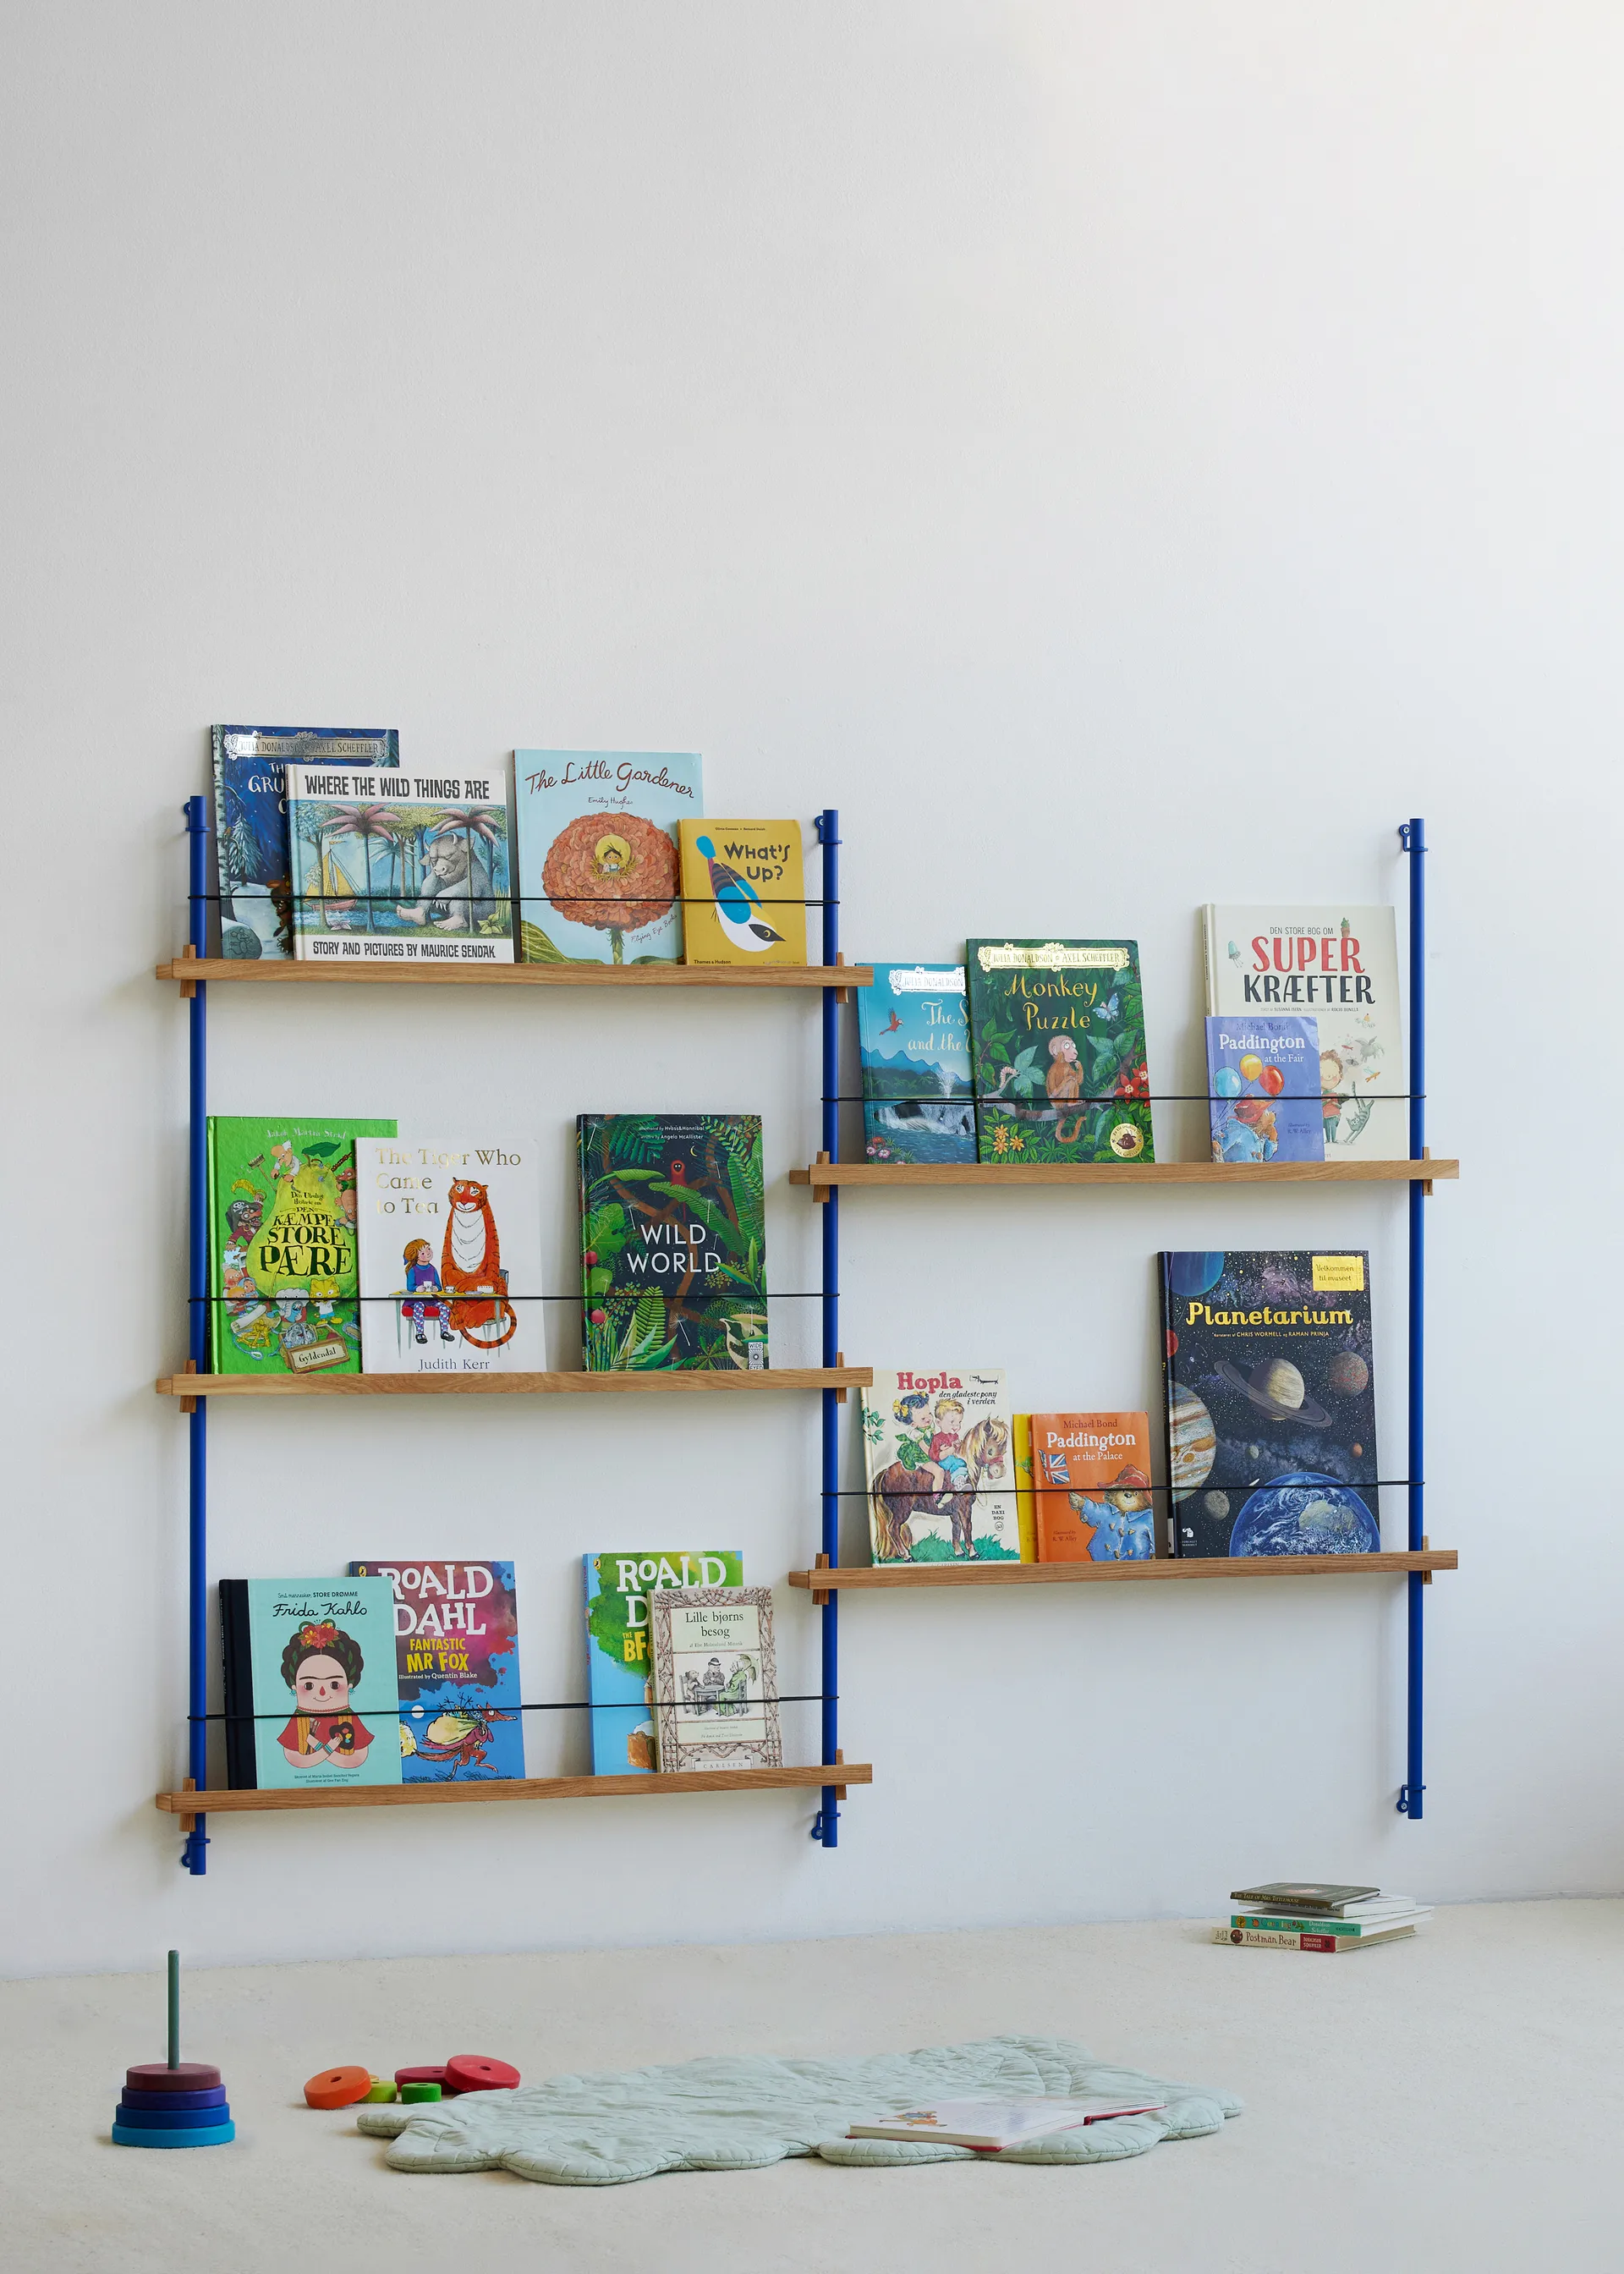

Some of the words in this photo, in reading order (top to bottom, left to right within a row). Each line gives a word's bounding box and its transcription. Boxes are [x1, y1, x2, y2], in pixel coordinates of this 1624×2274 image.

[315, 742, 336, 753] AXEL
[337, 743, 378, 754] SCHEFFLER
[269, 762, 284, 774] TH
[304, 775, 348, 795] WHERE
[352, 777, 376, 796] THE
[380, 777, 410, 797] WILD
[414, 779, 459, 799] THINGS
[464, 780, 490, 799] ARE
[524, 770, 557, 794] The
[561, 760, 613, 784] Little
[616, 762, 694, 798] Gardener
[588, 797, 609, 808] Emily
[724, 841, 790, 862] What's
[747, 865, 783, 882] Up?
[631, 932, 651, 943] Flying
[652, 926, 663, 935] Eye
[313, 941, 339, 955] STORY
[343, 942, 360, 955] AND
[364, 943, 403, 956] PICTURES
[406, 944, 418, 957] BY
[421, 944, 459, 958] MAURICE
[461, 945, 496, 958] SENDAK
[992, 953, 1011, 963] JULIA
[1013, 953, 1053, 963] DONALDSON
[1062, 953, 1081, 963] AXEL
[1082, 953, 1120, 963] SCHEFFLER
[1251, 936, 1365, 974] SUPER
[1004, 974, 1097, 1008] Monkey
[1244, 975, 1375, 1004] KRÆFTER
[921, 998, 955, 1025] The
[1023, 1002, 1090, 1030] Puzzle
[1237, 1022, 1265, 1031] Michael
[1268, 1022, 1289, 1031] Bond
[908, 1032, 935, 1051] and
[937, 1033, 963, 1051] the
[1219, 1034, 1305, 1053] Paddington
[1273, 1054, 1287, 1063] the
[1287, 1054, 1304, 1063] Fair
[375, 1147, 412, 1164] The
[418, 1148, 470, 1169] Tiger
[475, 1149, 521, 1166] Who
[376, 1173, 432, 1189] Came
[376, 1199, 395, 1214] to
[401, 1197, 438, 1214] Tea
[267, 1226, 346, 1246] STORE
[640, 1224, 706, 1244] WILD
[259, 1245, 353, 1277] PÆRE
[627, 1252, 721, 1273] WORLD
[1186, 1302, 1353, 1326] Planetarium
[299, 1347, 336, 1364] Gyldendal
[418, 1359, 457, 1371] Judith
[463, 1359, 491, 1370] Kerr
[897, 1372, 963, 1394] Hopla
[952, 1391, 980, 1399] gladeste
[1063, 1420, 1094, 1429] Michael
[1096, 1419, 1118, 1428] Bond
[1046, 1431, 1136, 1451] Paddington
[1083, 1452, 1095, 1460] the
[1097, 1451, 1123, 1460] Palace
[378, 1565, 493, 1600] ROALD
[616, 1556, 727, 1592] ROALD
[272, 1601, 319, 1617] Frida
[321, 1601, 367, 1615] Kahlo
[685, 1611, 708, 1623] Lille
[712, 1611, 743, 1624] bjørns
[393, 1602, 486, 1637] DAHL
[701, 1626, 730, 1639] besøg
[409, 1638, 465, 1651] FANTASTIC
[624, 1631, 650, 1662] BF
[407, 1652, 433, 1673] MR
[439, 1651, 469, 1672] FOX
[1246, 1932, 1277, 1944] Postman
[1279, 1935, 1297, 1947] Bear
